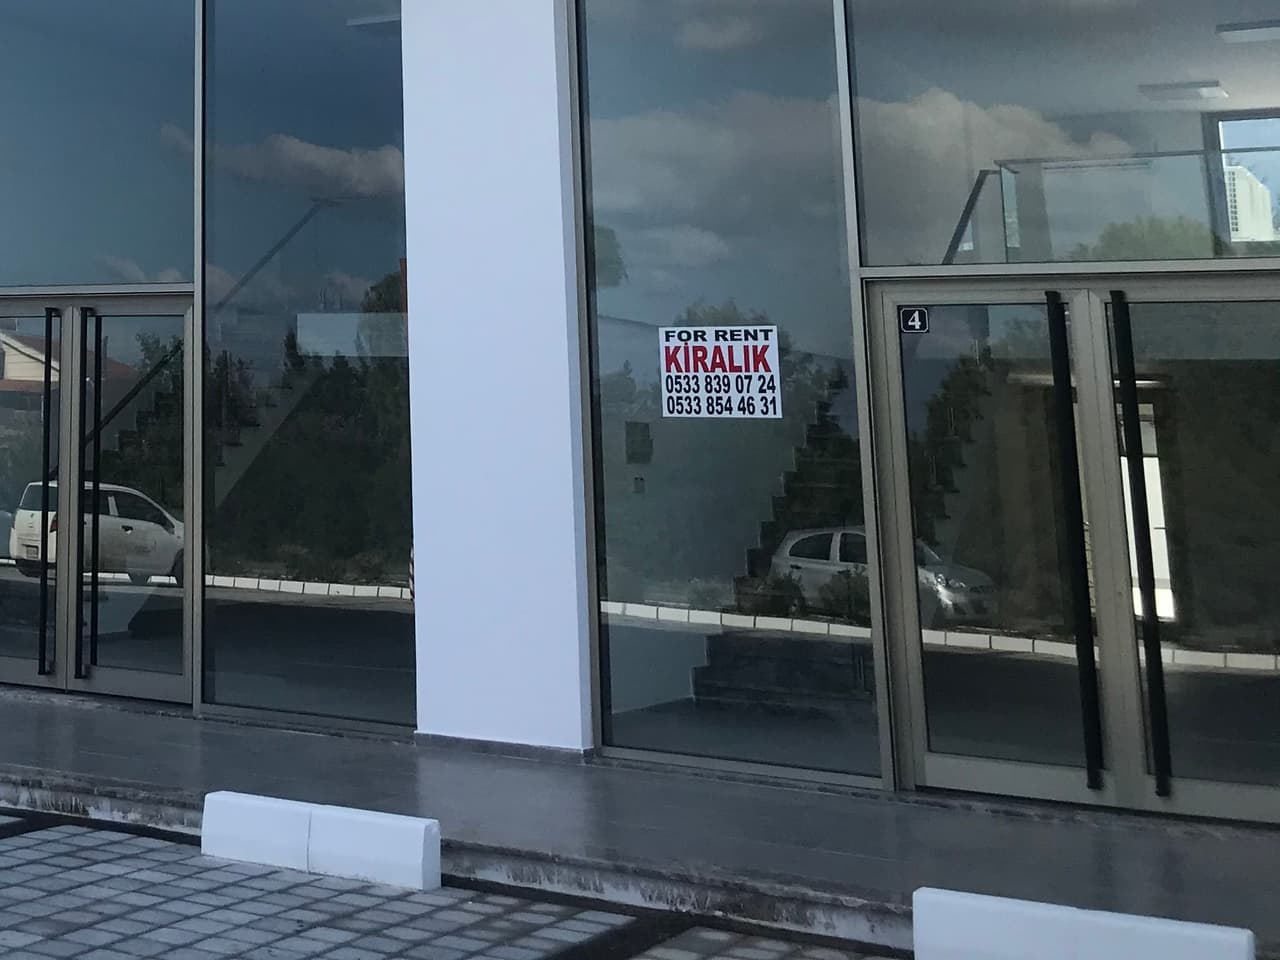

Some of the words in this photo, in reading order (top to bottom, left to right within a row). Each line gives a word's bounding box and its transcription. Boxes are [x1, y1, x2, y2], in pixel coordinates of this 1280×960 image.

[908, 310, 922, 330] 4
[664, 330, 707, 342] FOR
[714, 329, 773, 342] RENT
[664, 342, 772, 373] KİRALIK
[665, 375, 700, 394] 0533
[704, 375, 731, 394] 839
[735, 375, 753, 393] 07
[757, 374, 776, 394] 24
[667, 396, 701, 415] 0533
[706, 396, 733, 415] 854
[737, 396, 756, 415] 46
[760, 396, 777, 415] 31
